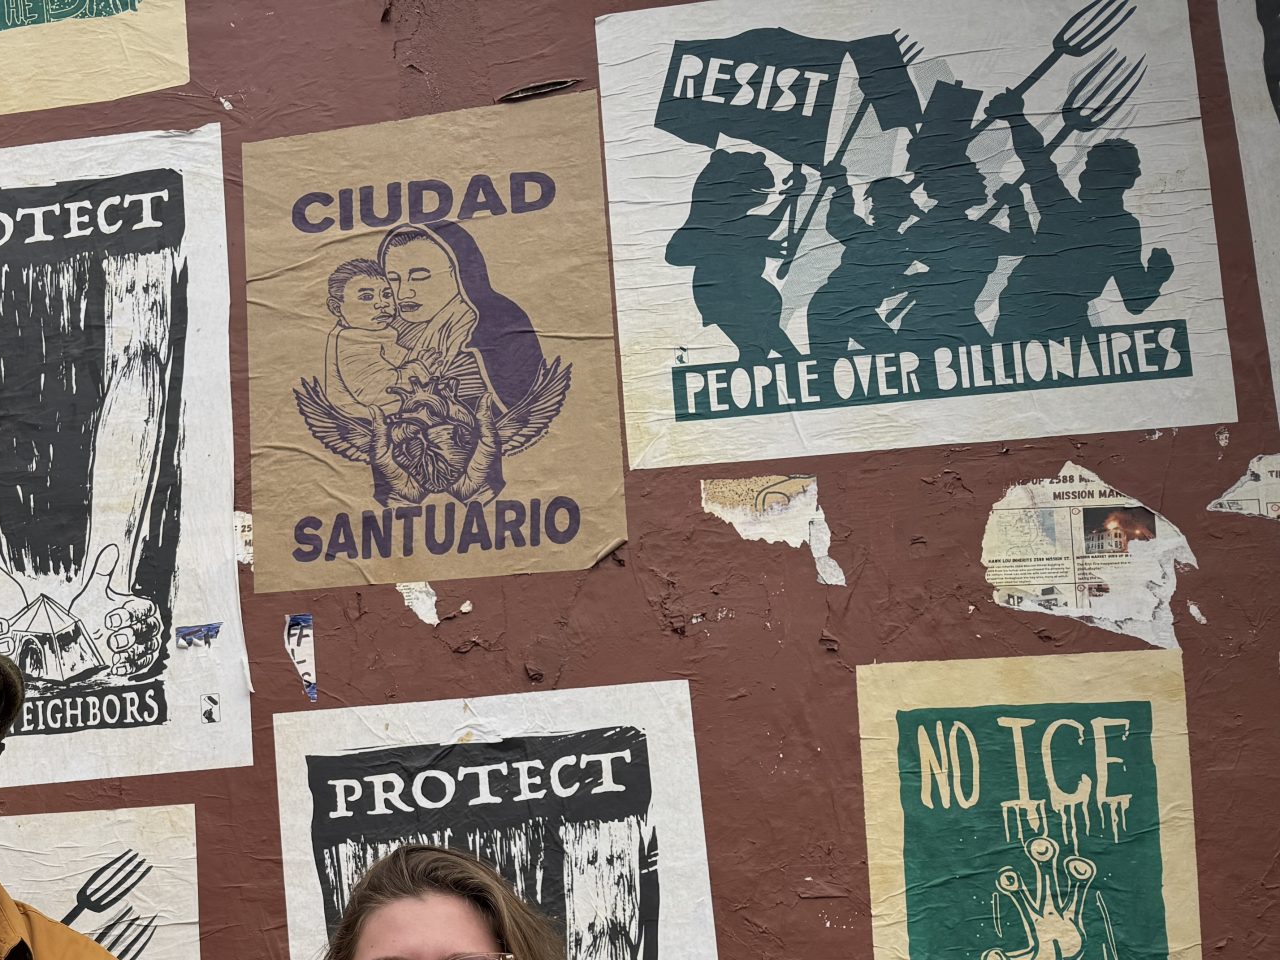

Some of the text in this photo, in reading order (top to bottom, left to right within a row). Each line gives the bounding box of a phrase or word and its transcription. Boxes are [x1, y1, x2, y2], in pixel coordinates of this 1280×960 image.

[673, 54, 829, 117] RESIST
[291, 171, 556, 233] CIUDAD
[685, 327, 1182, 414] PEOPLE OVER BILLIONAIRES
[1053, 490, 1095, 501] MISSION
[241, 525, 253, 533] 25
[292, 496, 581, 562] SANTUARIO
[10, 689, 159, 734] EIGHBORS
[328, 749, 633, 819] PROTECT
[918, 716, 1133, 810] NO ICE
